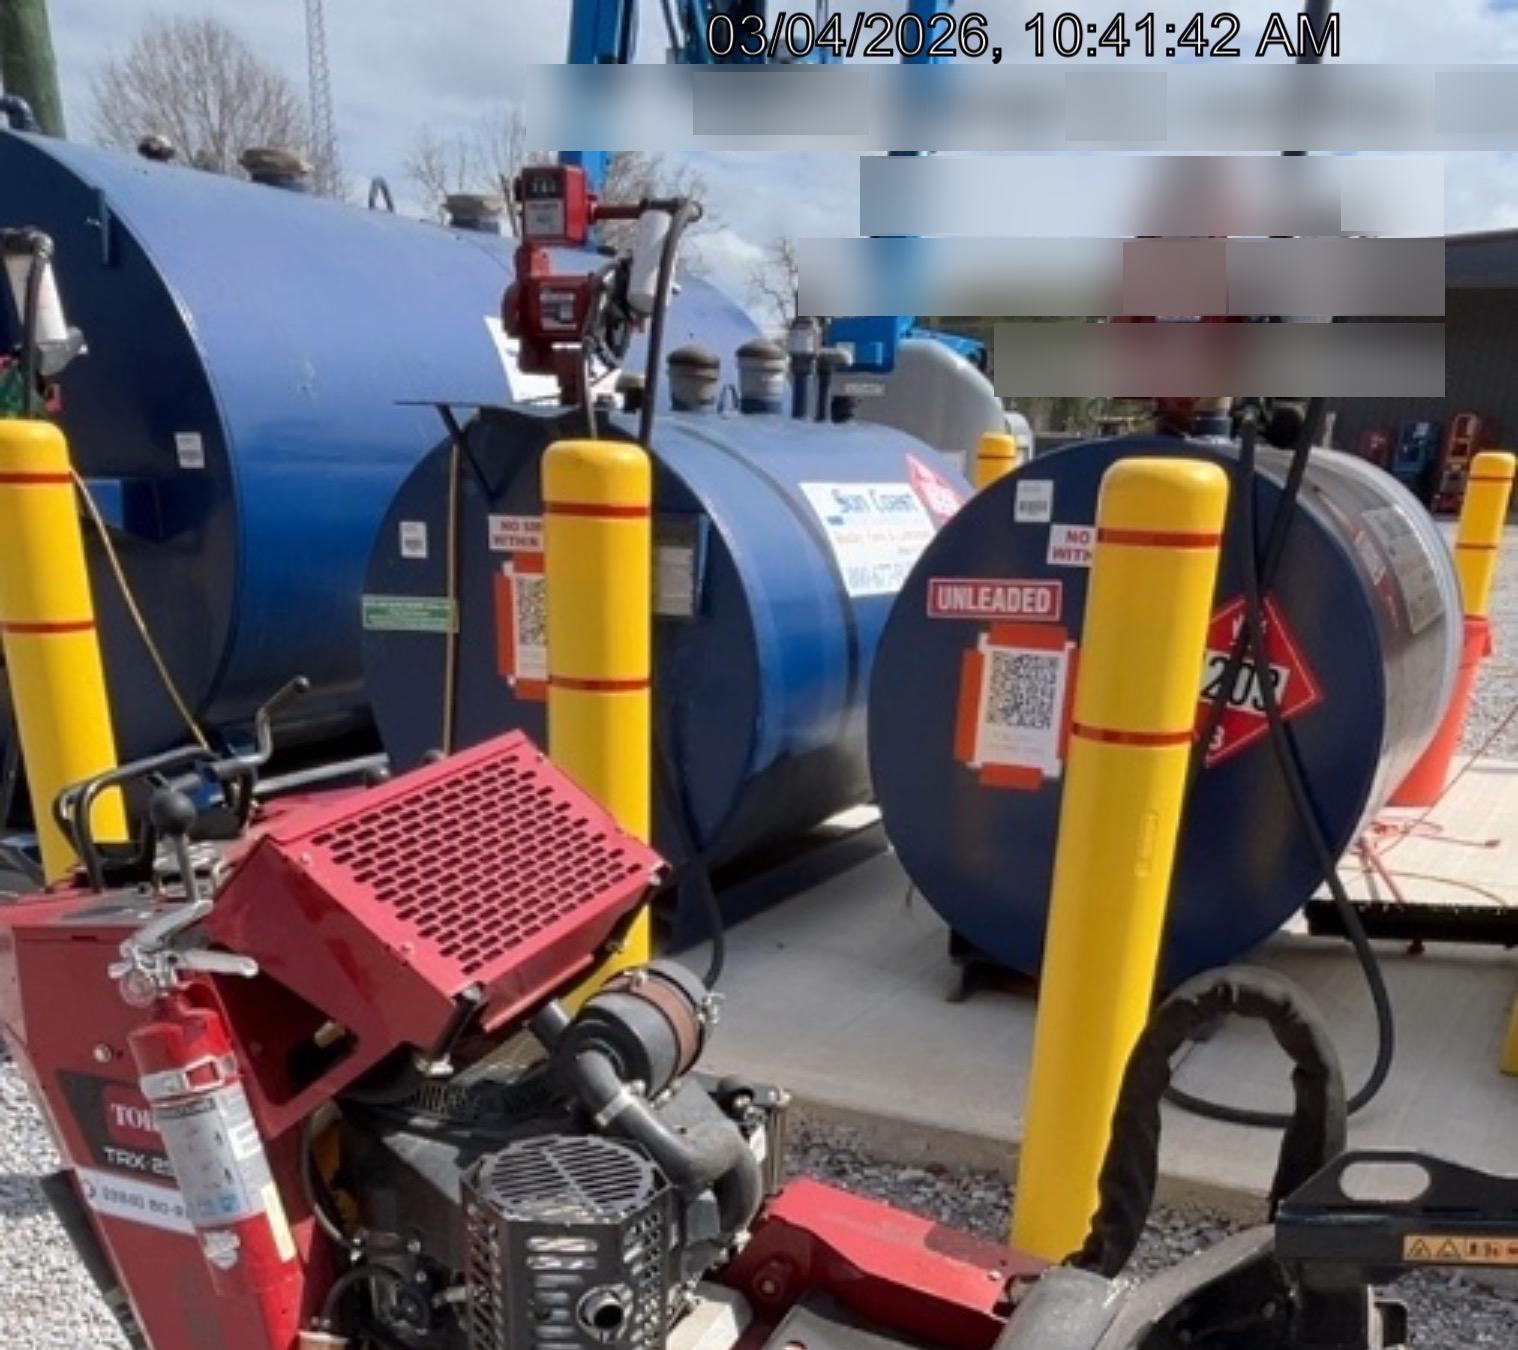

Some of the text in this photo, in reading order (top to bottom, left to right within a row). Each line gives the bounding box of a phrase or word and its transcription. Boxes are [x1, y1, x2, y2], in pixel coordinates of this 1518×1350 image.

[500, 521, 520, 532] NO
[1065, 530, 1090, 544] NO
[936, 585, 1053, 614] UNLEADED
